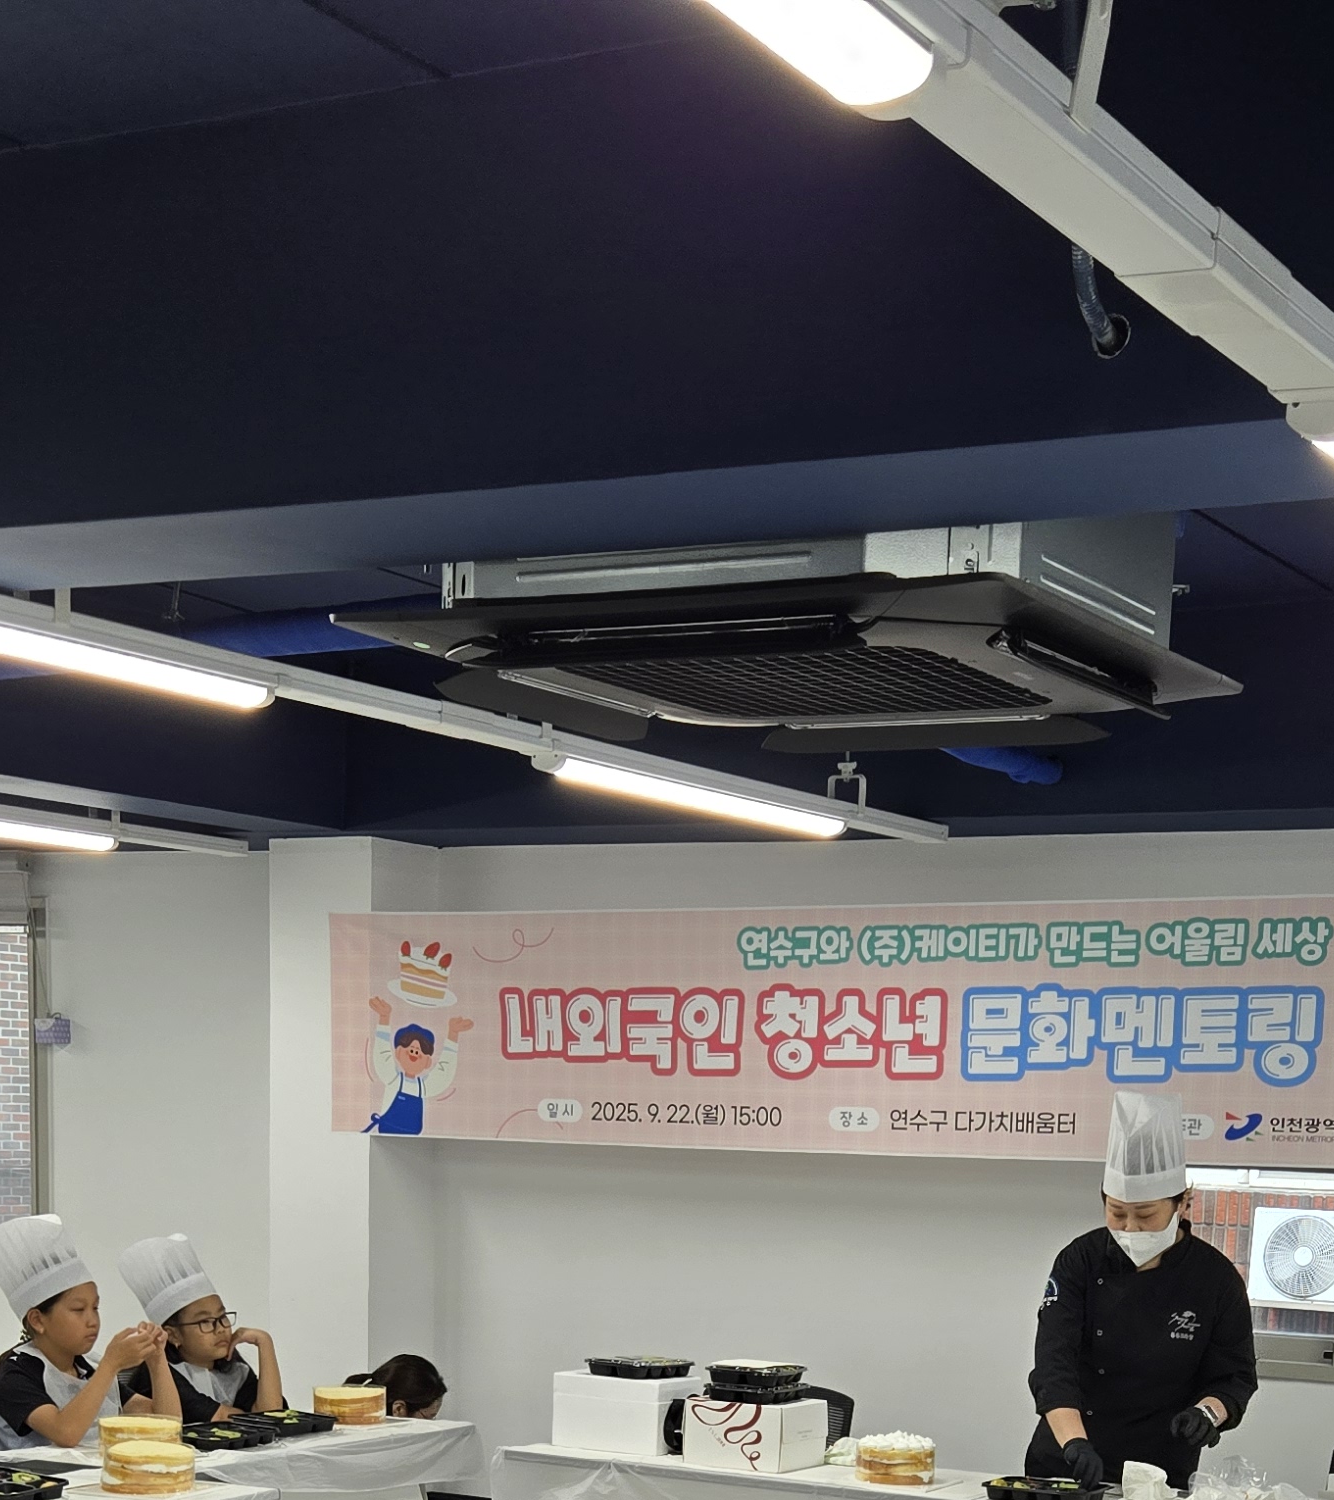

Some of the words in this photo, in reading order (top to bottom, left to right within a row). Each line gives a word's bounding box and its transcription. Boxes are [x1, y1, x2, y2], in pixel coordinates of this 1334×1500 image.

[739, 928, 851, 968] 연수구와
[859, 924, 1040, 965] (주)케이티가
[1048, 922, 1139, 966] 만드는
[1148, 918, 1247, 965] 어울림
[1254, 917, 1331, 964] 세상
[501, 988, 742, 1074] 내외국인
[757, 985, 946, 1078] 청소년
[963, 985, 1322, 1085] 문화멘토링
[591, 1101, 642, 1123] 2025.
[647, 1103, 661, 1123] 9.
[667, 1104, 726, 1126] 22.(월)
[731, 1105, 782, 1127] 15:00
[890, 1109, 948, 1132] 연수구
[954, 1111, 1076, 1135] 다가치배움터
[1272, 1134, 1304, 1143] INCHEON
